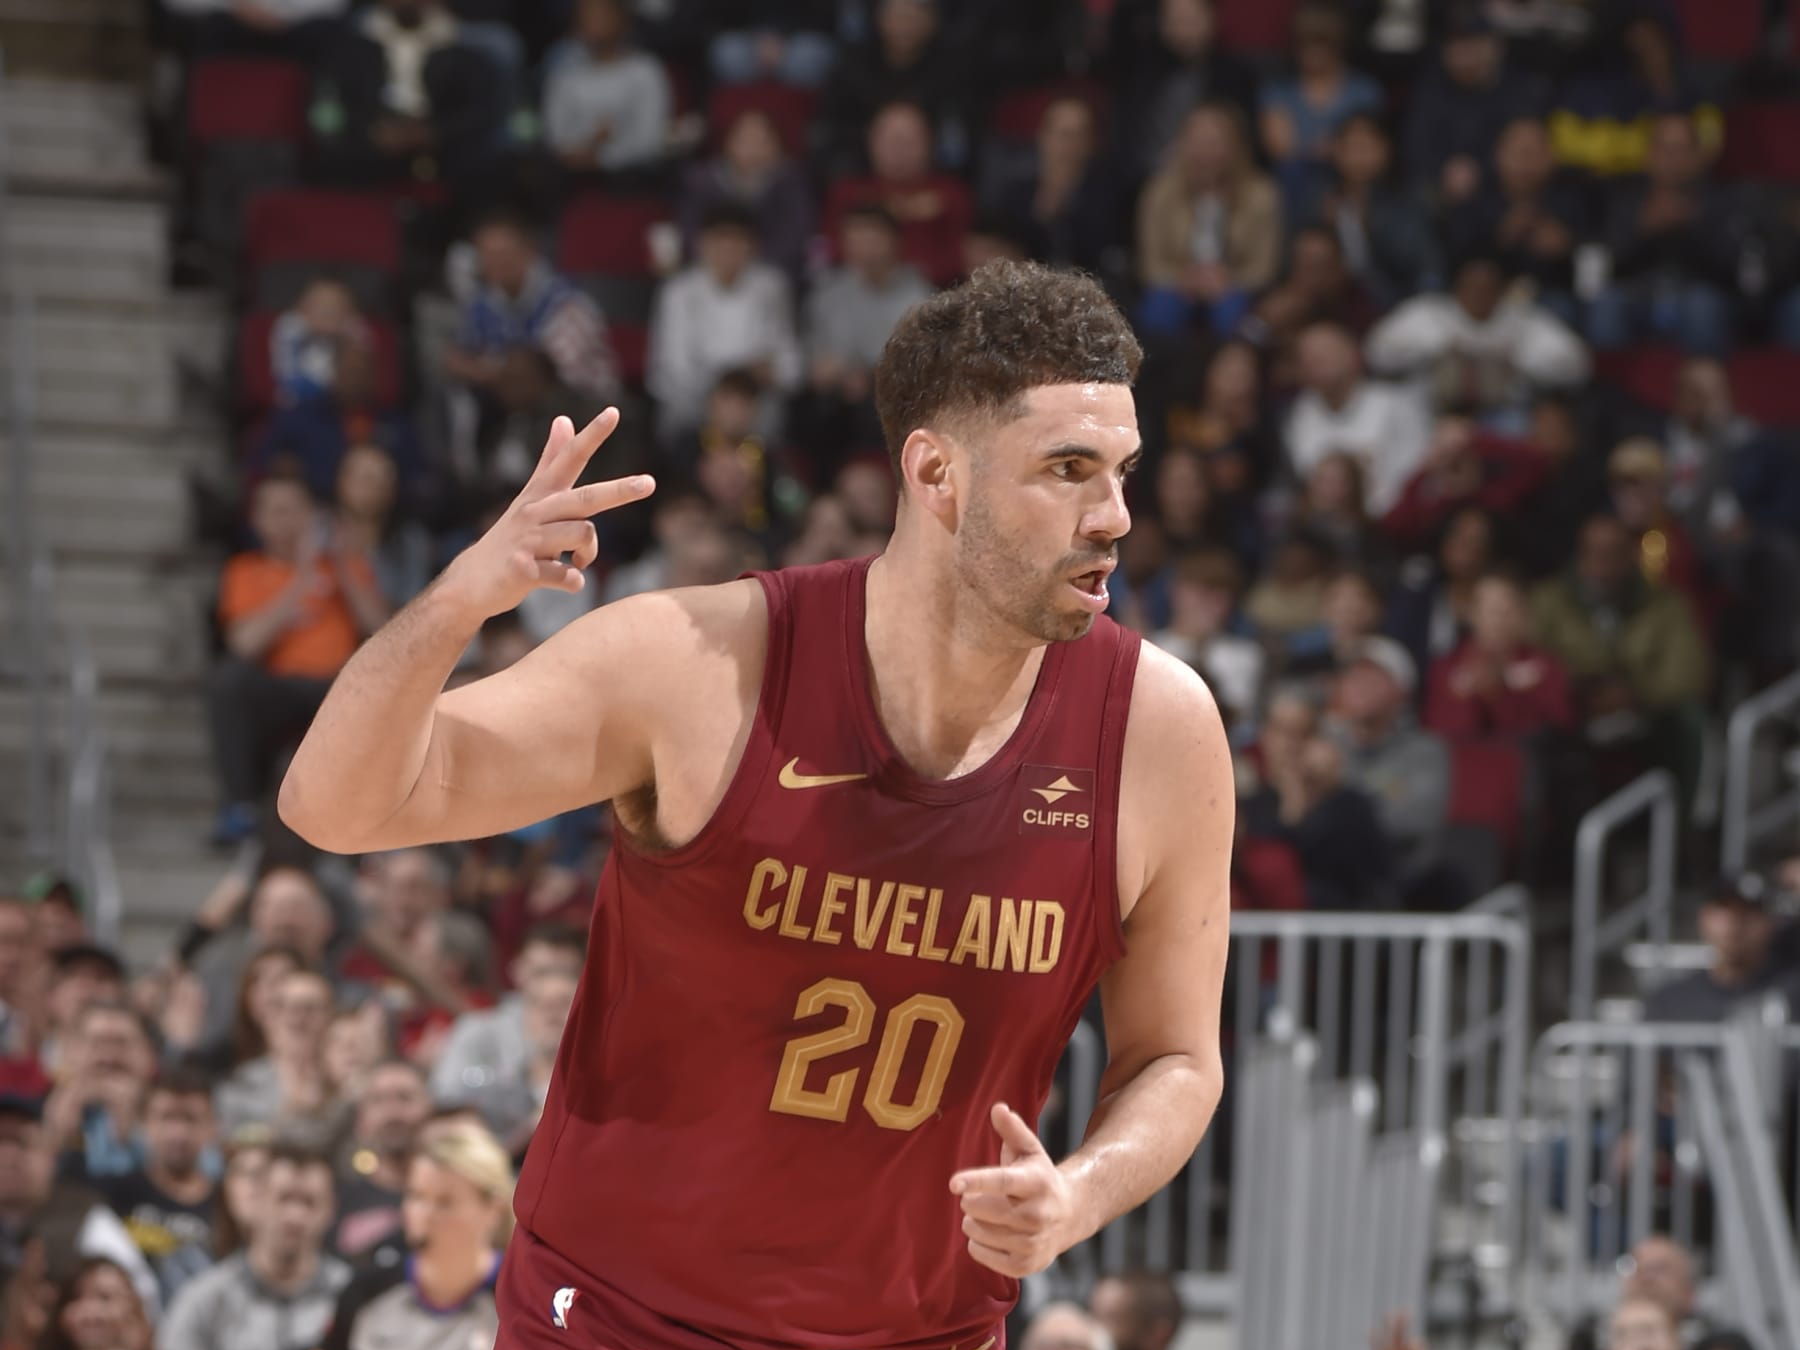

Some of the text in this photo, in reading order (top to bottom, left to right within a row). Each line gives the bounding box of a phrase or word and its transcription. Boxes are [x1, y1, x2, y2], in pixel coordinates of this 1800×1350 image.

[1023, 808, 1090, 829] CLIFFS
[743, 857, 1065, 973] CLEVELAND
[769, 977, 965, 1131] 20
